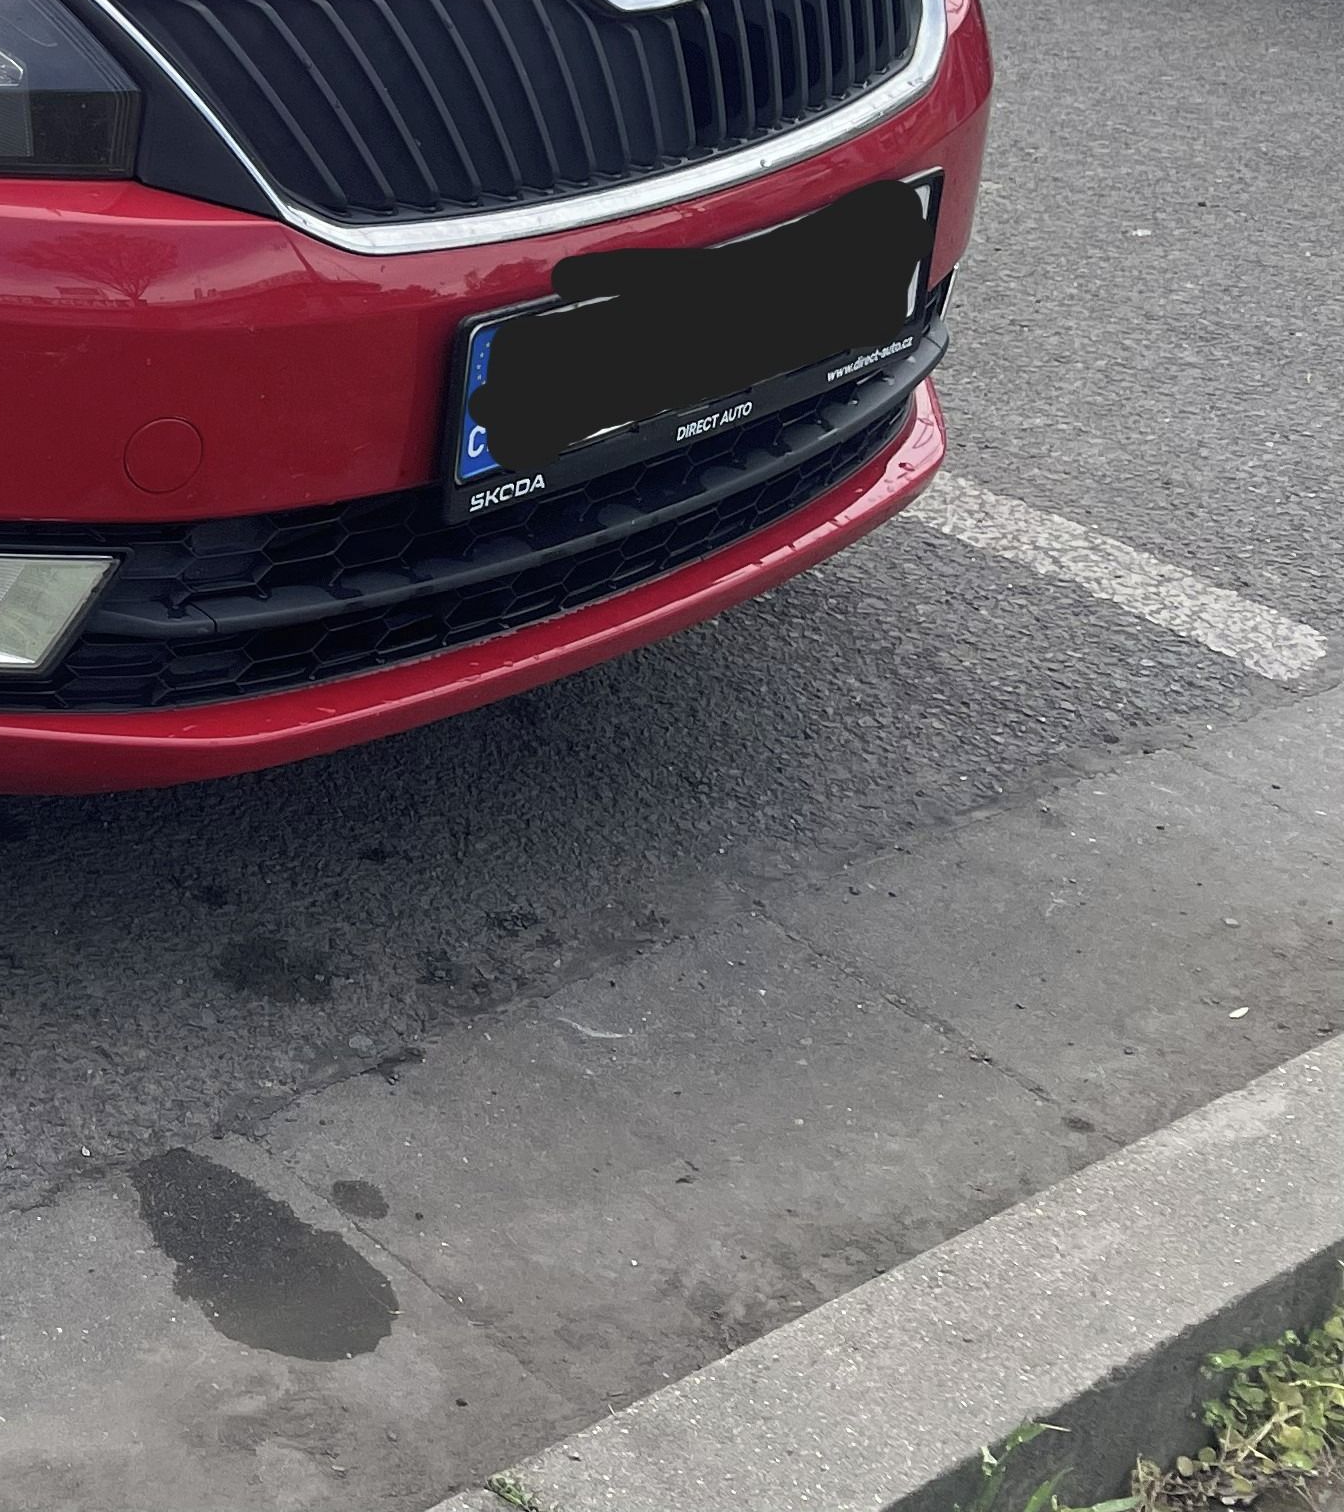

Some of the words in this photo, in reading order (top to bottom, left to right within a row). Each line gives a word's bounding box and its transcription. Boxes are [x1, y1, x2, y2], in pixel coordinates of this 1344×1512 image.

[827, 335, 914, 382] www.direct-auto.cz
[467, 424, 489, 458] C
[676, 413, 720, 442] DIRECT
[720, 401, 753, 426] AUTO
[469, 473, 546, 513] SKODA
